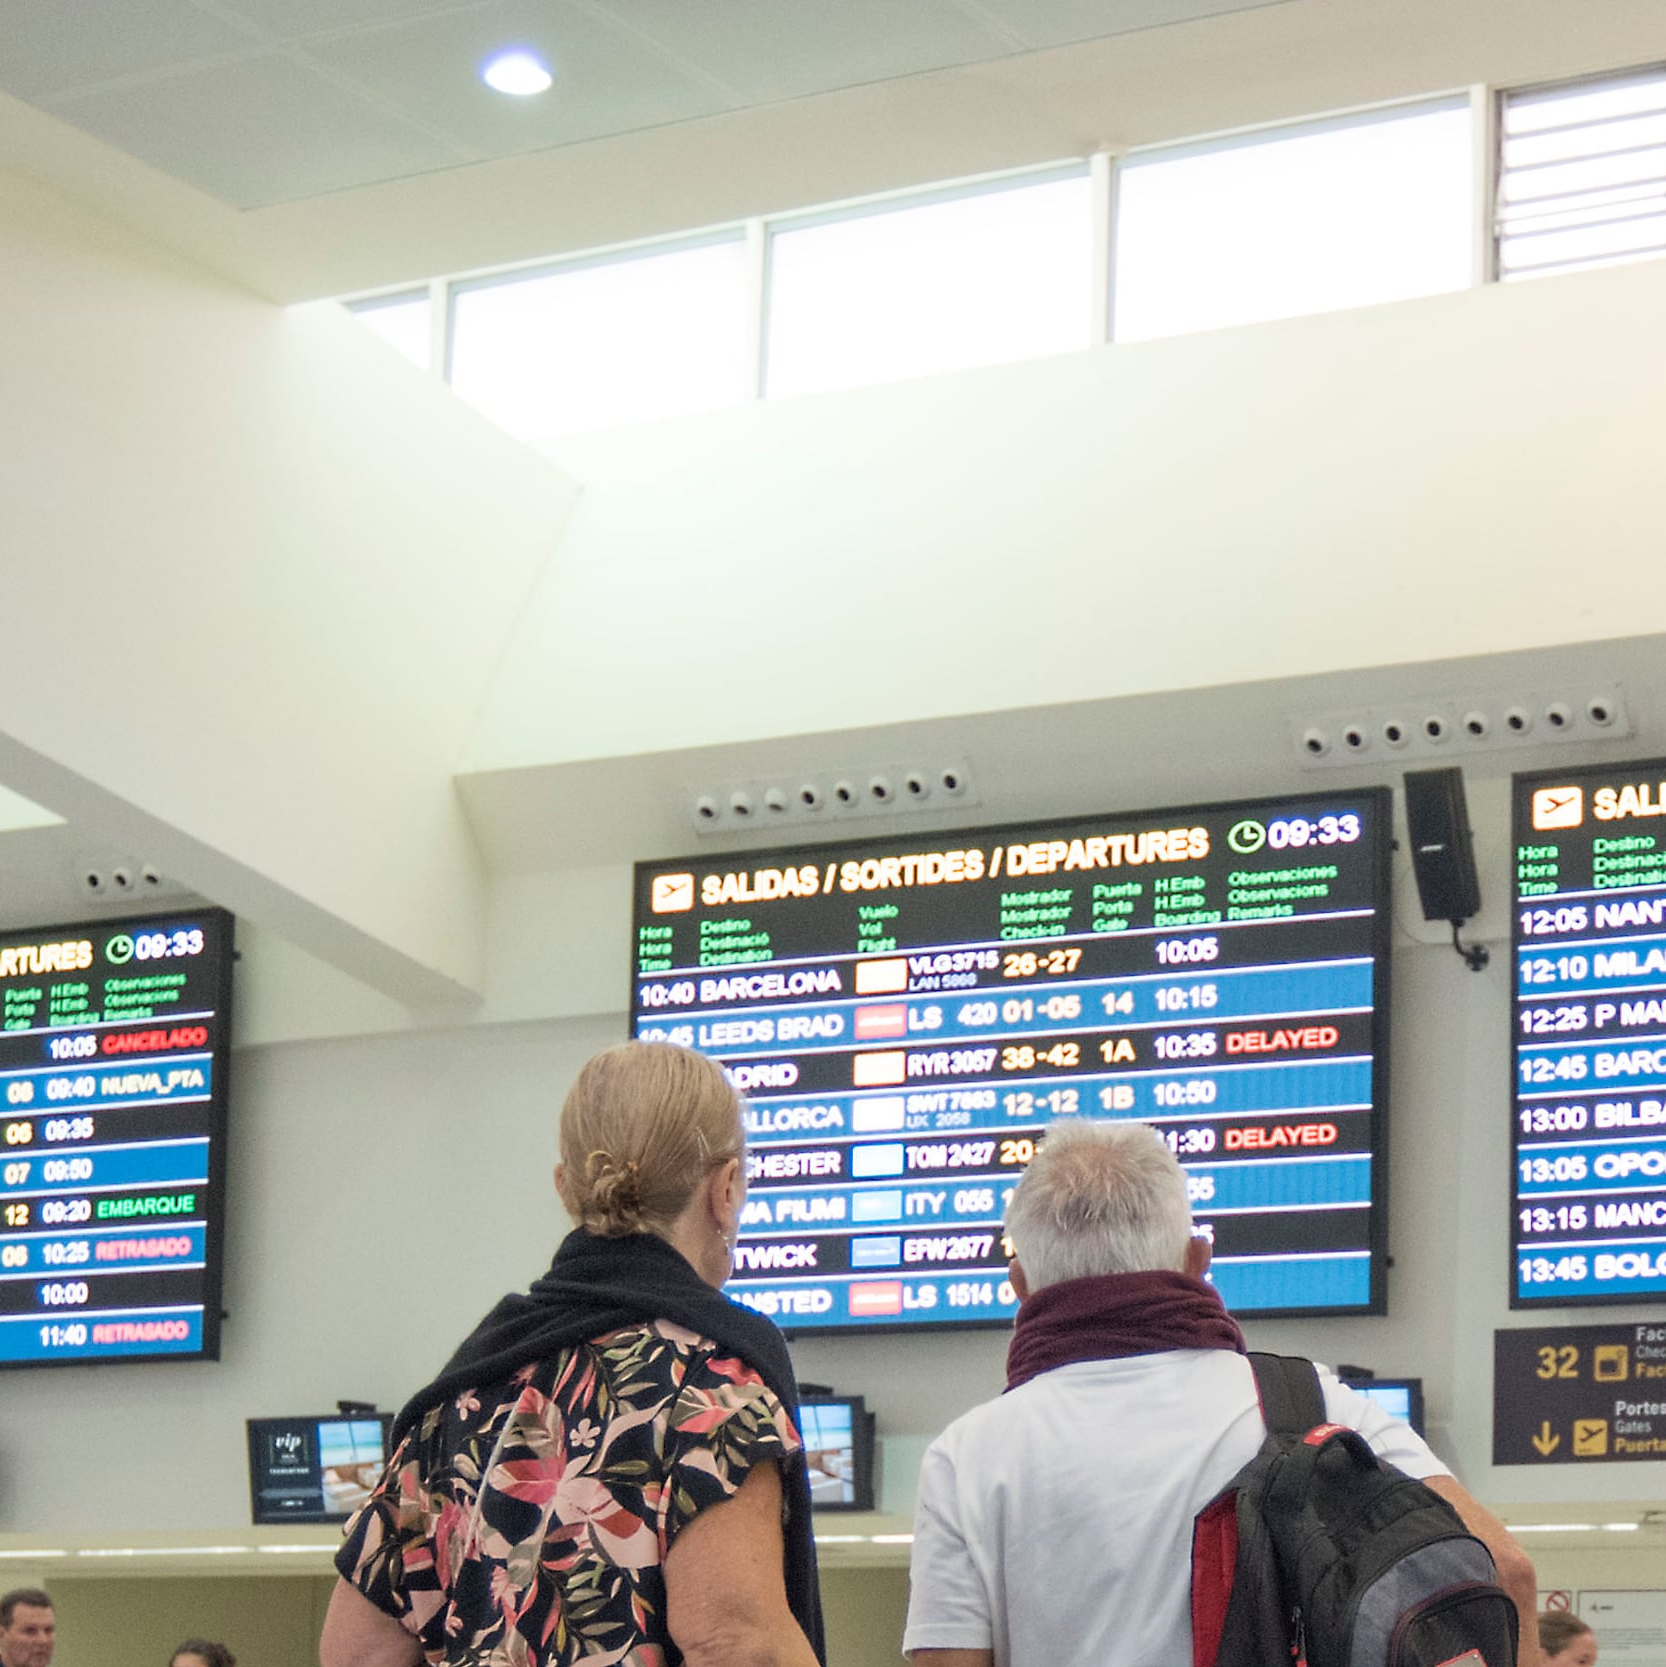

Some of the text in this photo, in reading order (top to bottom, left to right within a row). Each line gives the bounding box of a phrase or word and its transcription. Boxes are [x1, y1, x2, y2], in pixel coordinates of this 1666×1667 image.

[699, 813, 1362, 907] SALIDAS SORTIDES DEPARTURES 09:33
[1516, 844, 1560, 863] Hora
[1591, 834, 1657, 856] Destino
[1516, 862, 1561, 880] Hora
[1517, 880, 1559, 897] Time
[1518, 905, 1589, 936] 12:05
[134, 928, 205, 962] 09:33
[1518, 954, 1590, 985] 12:10
[639, 968, 843, 1008] 10:40 BARCELONA
[697, 1012, 846, 1048] LEEDS BRAD
[1519, 1004, 1589, 1035] 12:25
[1593, 1002, 1618, 1029] P
[1098, 1025, 1340, 1064] 1A DELAYED
[1517, 1053, 1590, 1084] 12:45
[1519, 1104, 1590, 1134] 13:00
[1222, 1121, 1339, 1152] DELAYED
[1518, 1153, 1589, 1184] 13:05
[95, 1193, 196, 1220] EMBARQUE
[1518, 1204, 1589, 1234] 13:15
[1517, 1254, 1589, 1284] 13:45
[1537, 1346, 1578, 1379] 32
[1615, 1419, 1651, 1433] Gates
[276, 1433, 301, 1452] vip
